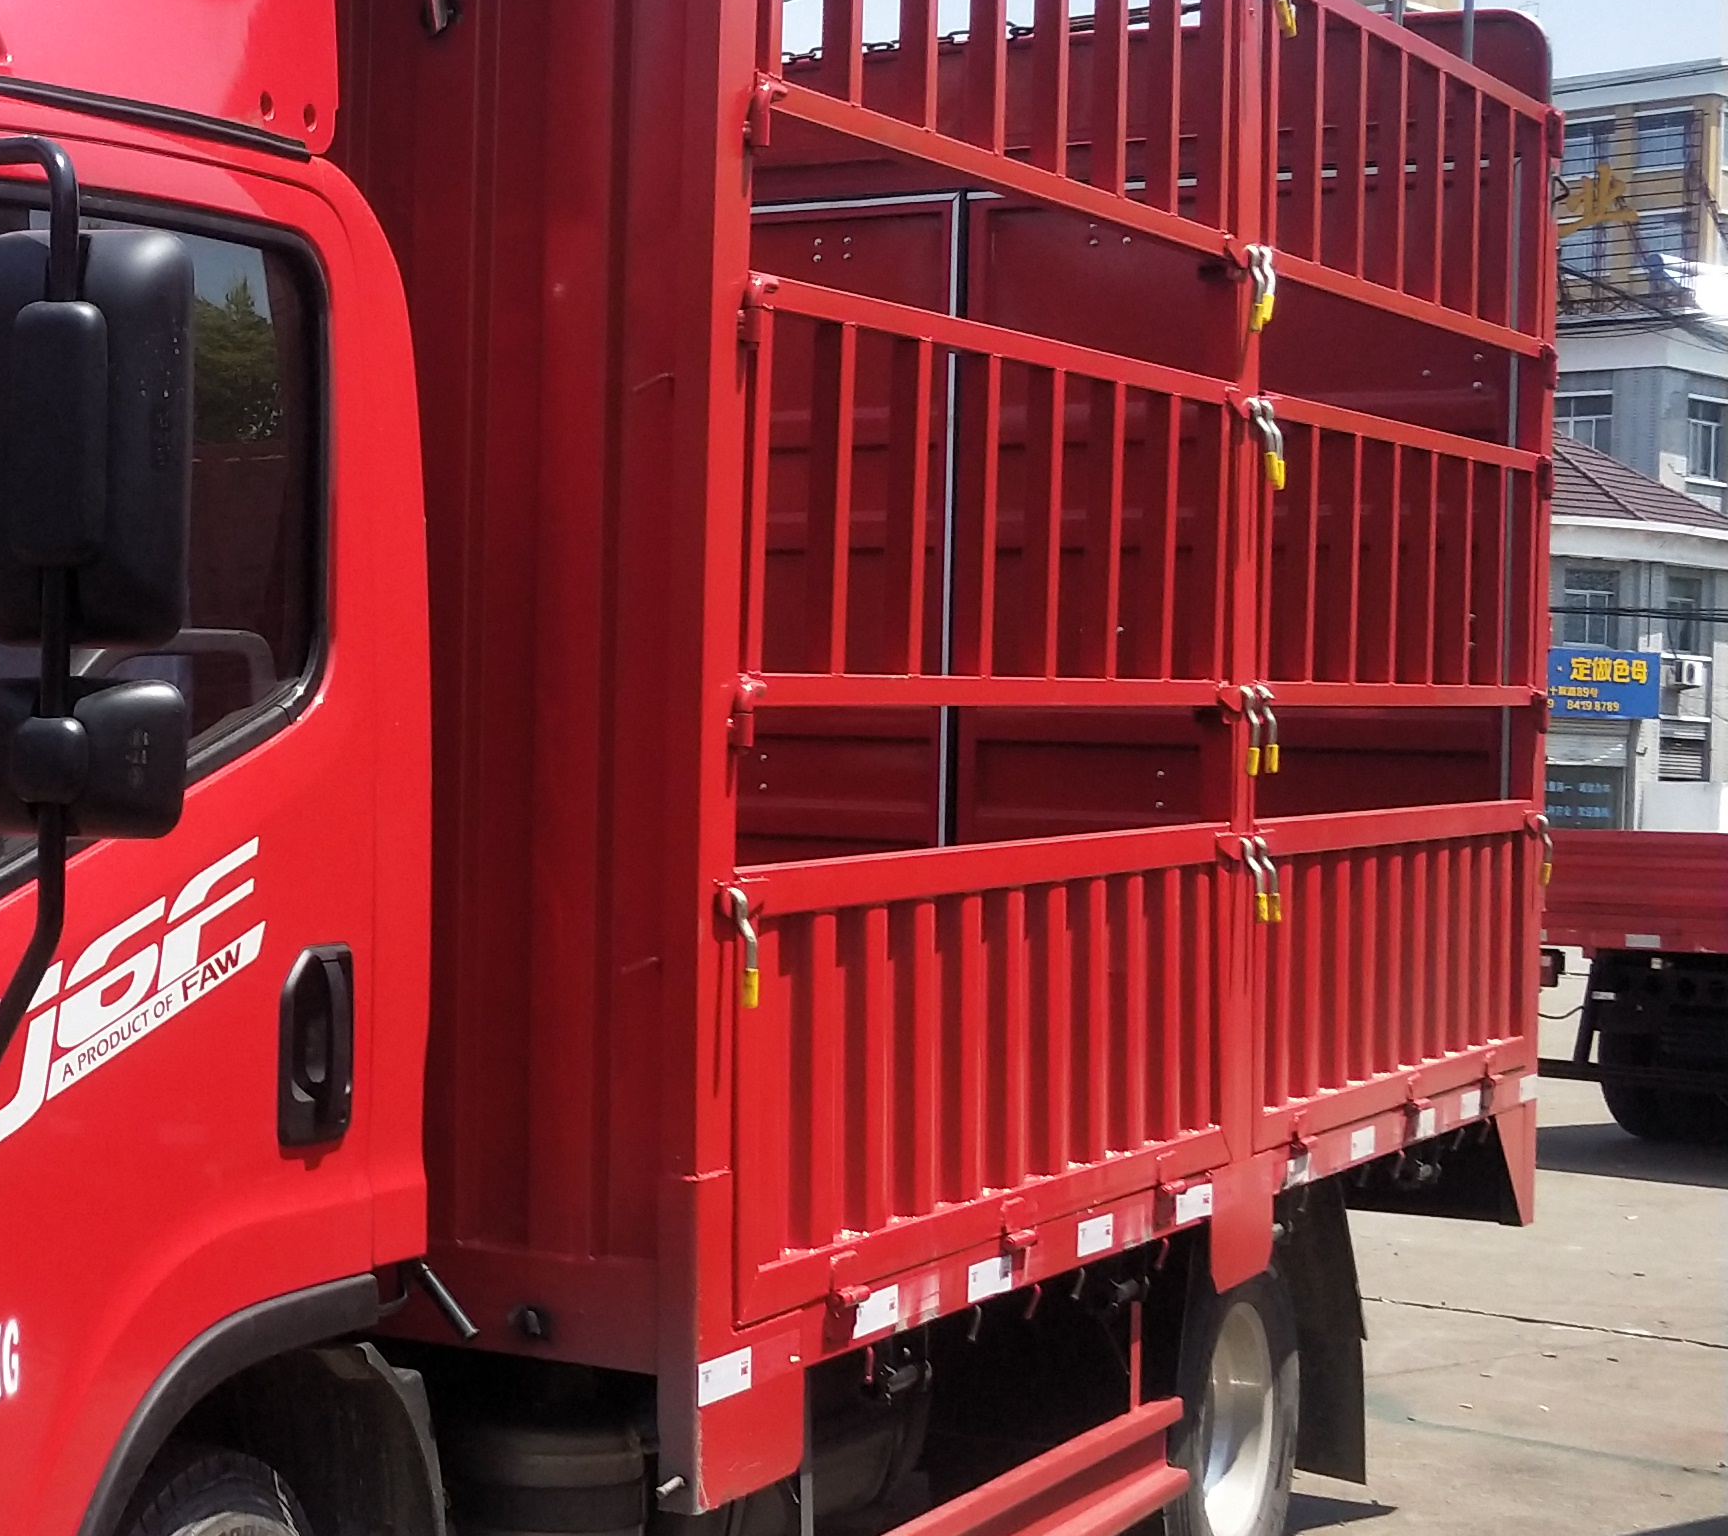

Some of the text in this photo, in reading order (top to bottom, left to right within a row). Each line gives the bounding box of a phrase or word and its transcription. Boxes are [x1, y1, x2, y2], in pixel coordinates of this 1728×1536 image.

[1570, 657, 1648, 684] 定做色母
[62, 943, 242, 1082] A PRODUCT OF FAW
